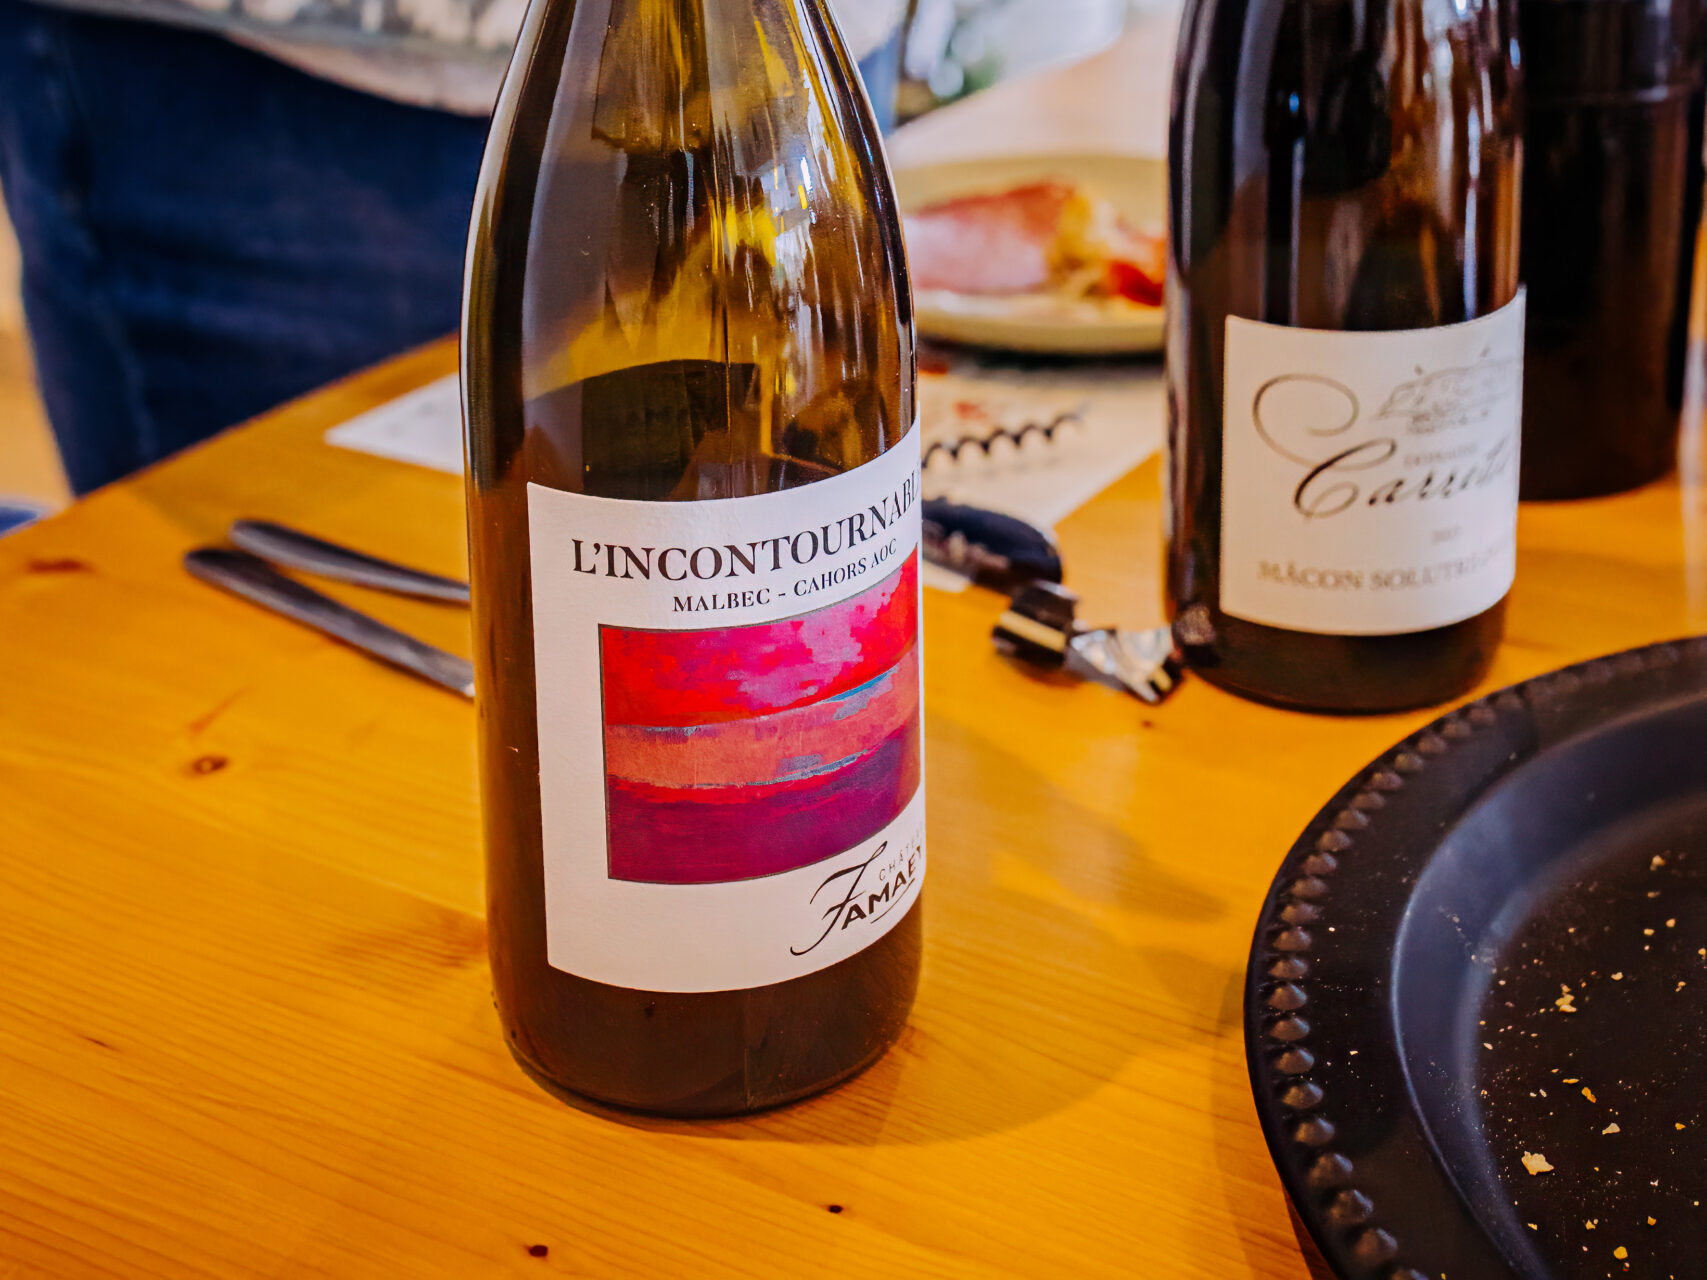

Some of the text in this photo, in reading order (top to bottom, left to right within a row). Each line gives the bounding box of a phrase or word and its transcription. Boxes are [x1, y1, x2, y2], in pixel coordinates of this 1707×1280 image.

[571, 464, 920, 581] L’INCONTOURNABL
[673, 587, 771, 612] MALBEC
[793, 557, 867, 598] CAHORS
[870, 537, 897, 569] AOC
